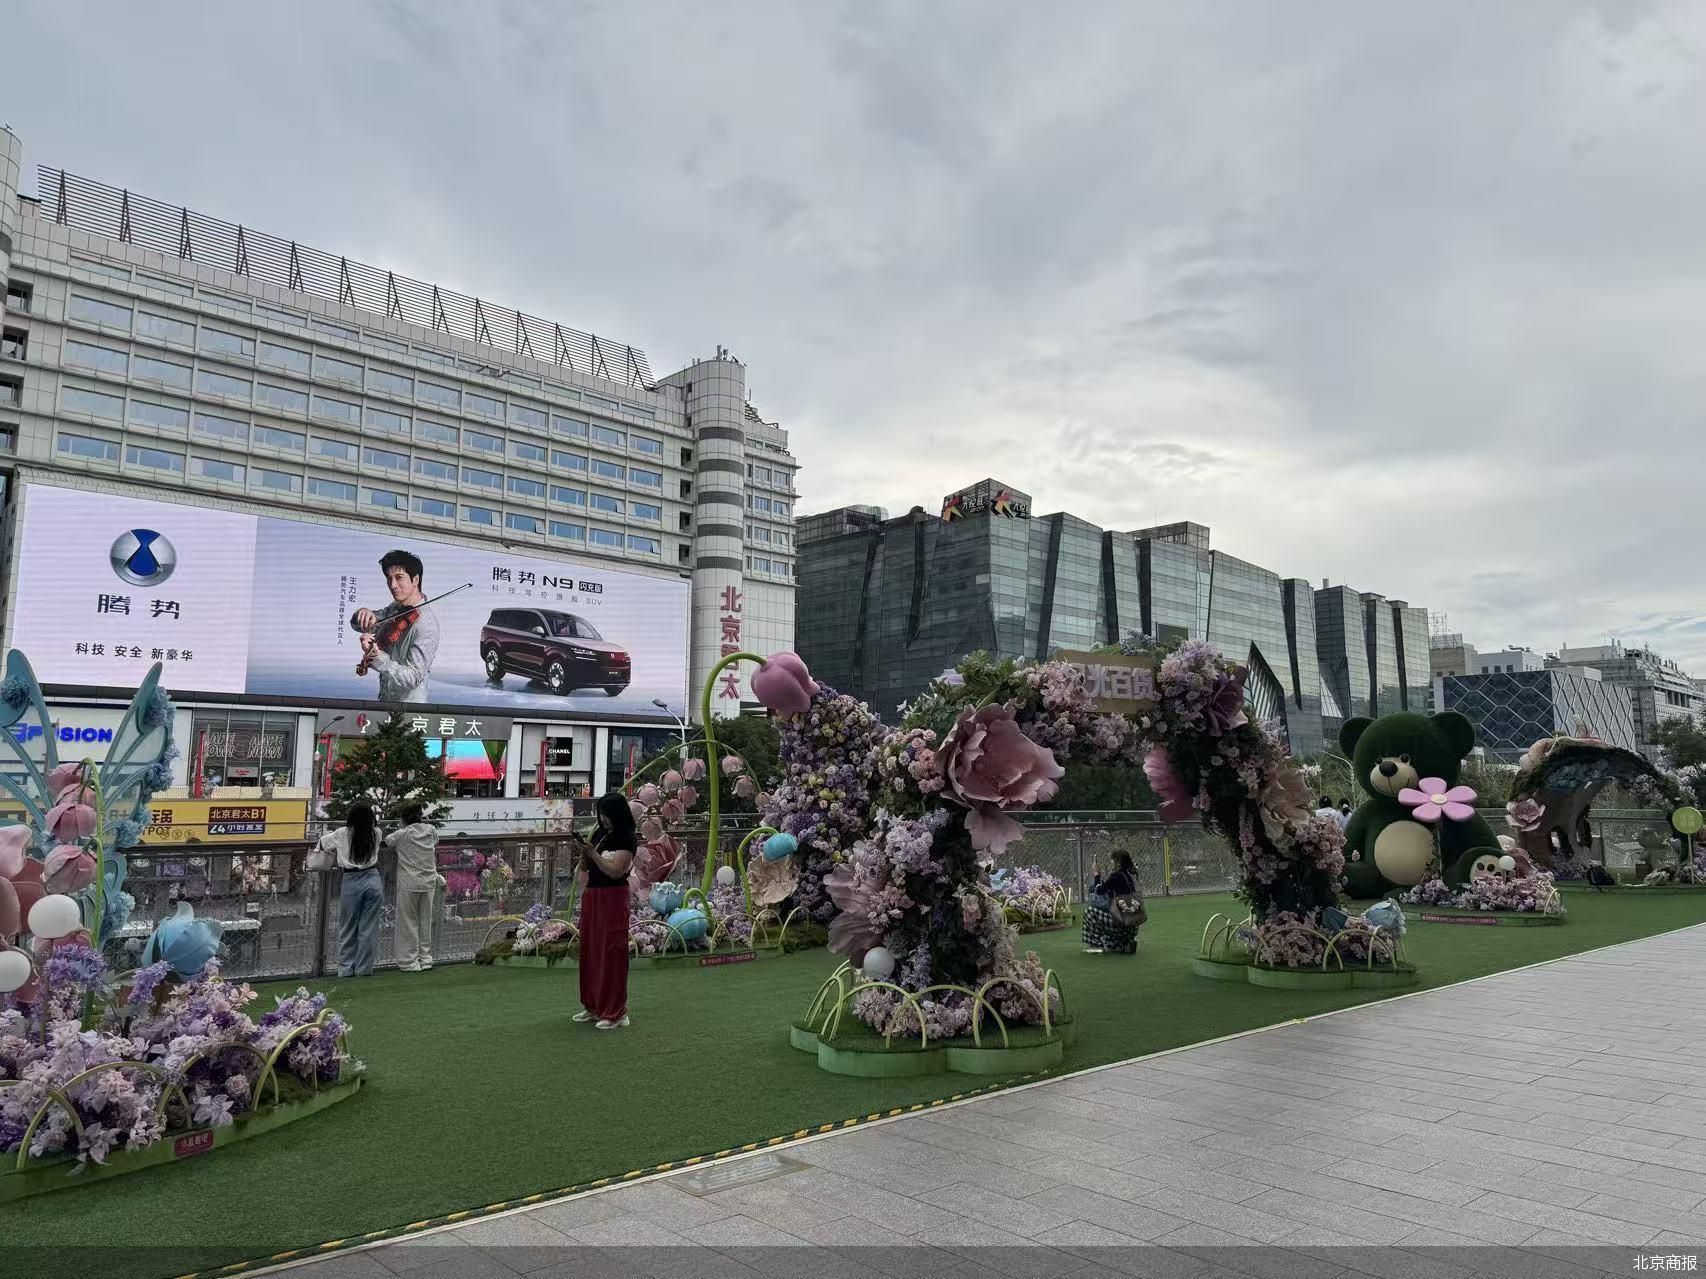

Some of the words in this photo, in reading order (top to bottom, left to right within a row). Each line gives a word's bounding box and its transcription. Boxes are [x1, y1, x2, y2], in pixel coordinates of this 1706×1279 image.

[348, 576, 357, 603] 王力宏
[492, 567, 535, 585] 腾势
[542, 576, 573, 589] N9
[579, 581, 602, 593] 闪充版
[97, 593, 180, 619] 腾势
[586, 597, 603, 605] SUV
[75, 642, 105, 656] 科技
[114, 645, 143, 658] 安全
[151, 648, 193, 661] 新豪华
[246, 745, 284, 759] NOW!
[211, 808, 266, 819] 北京君太B1
